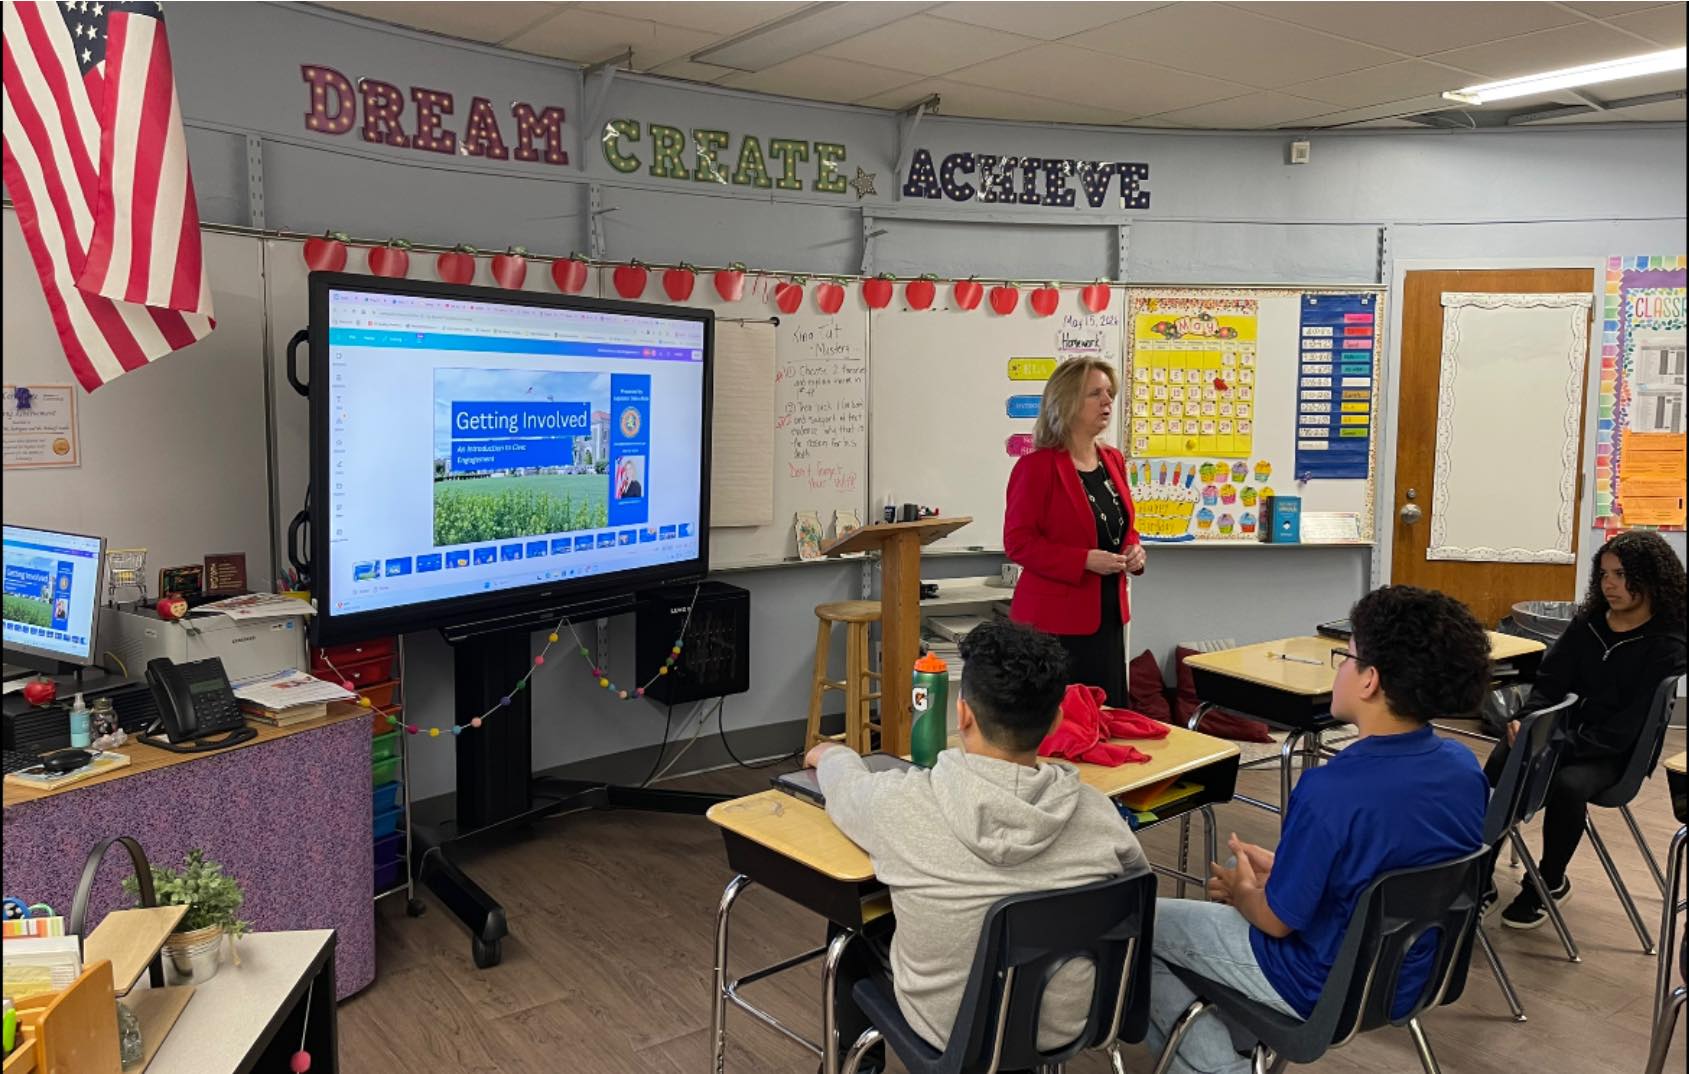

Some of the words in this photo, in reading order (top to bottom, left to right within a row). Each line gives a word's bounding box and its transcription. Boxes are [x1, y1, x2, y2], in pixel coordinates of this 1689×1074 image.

[300, 64, 568, 165] DREAM
[602, 119, 847, 194] CREATE
[903, 149, 1150, 209] ACHIEVE
[1064, 315, 1083, 329] May
[1179, 319, 1215, 333] May
[456, 411, 518, 434] Getting
[523, 410, 587, 429] Involved
